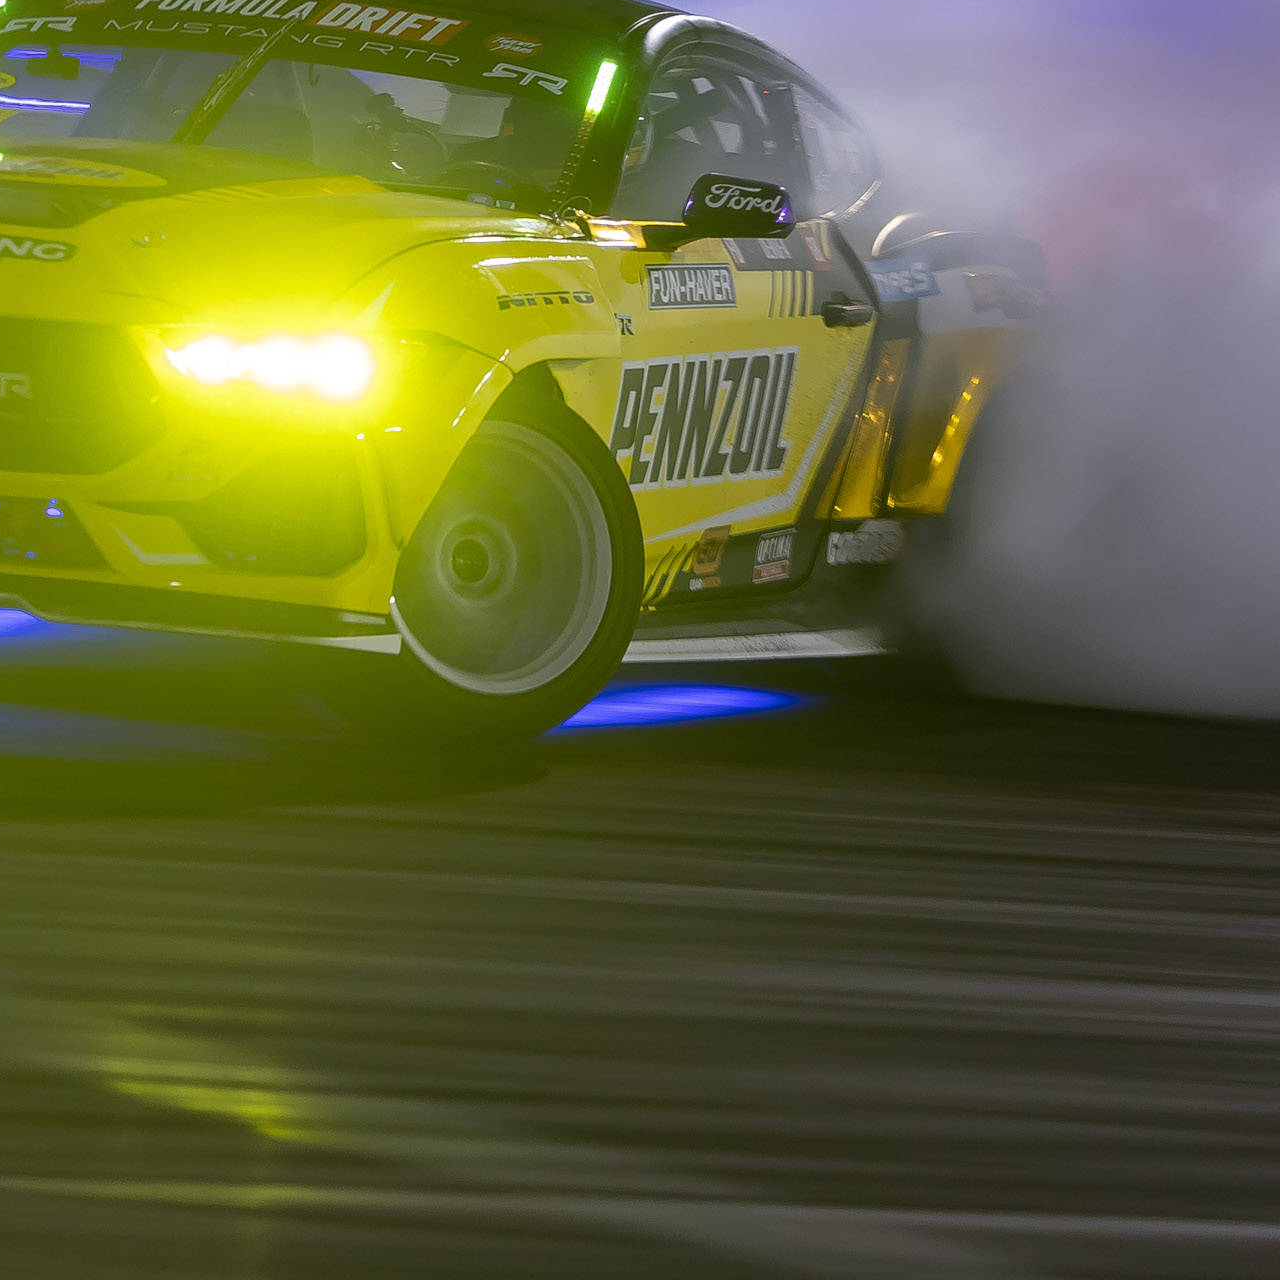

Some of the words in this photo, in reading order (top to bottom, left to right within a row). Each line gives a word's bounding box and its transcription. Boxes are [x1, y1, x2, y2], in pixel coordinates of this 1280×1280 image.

[317, 1, 463, 42] DRIFT
[104, 19, 346, 50] MUSTANG
[358, 41, 462, 68] RTR
[704, 183, 782, 216] Ford
[496, 290, 596, 311] NITTO
[649, 267, 735, 304] FUN-HAVER
[609, 347, 798, 490] PENNZOIL
